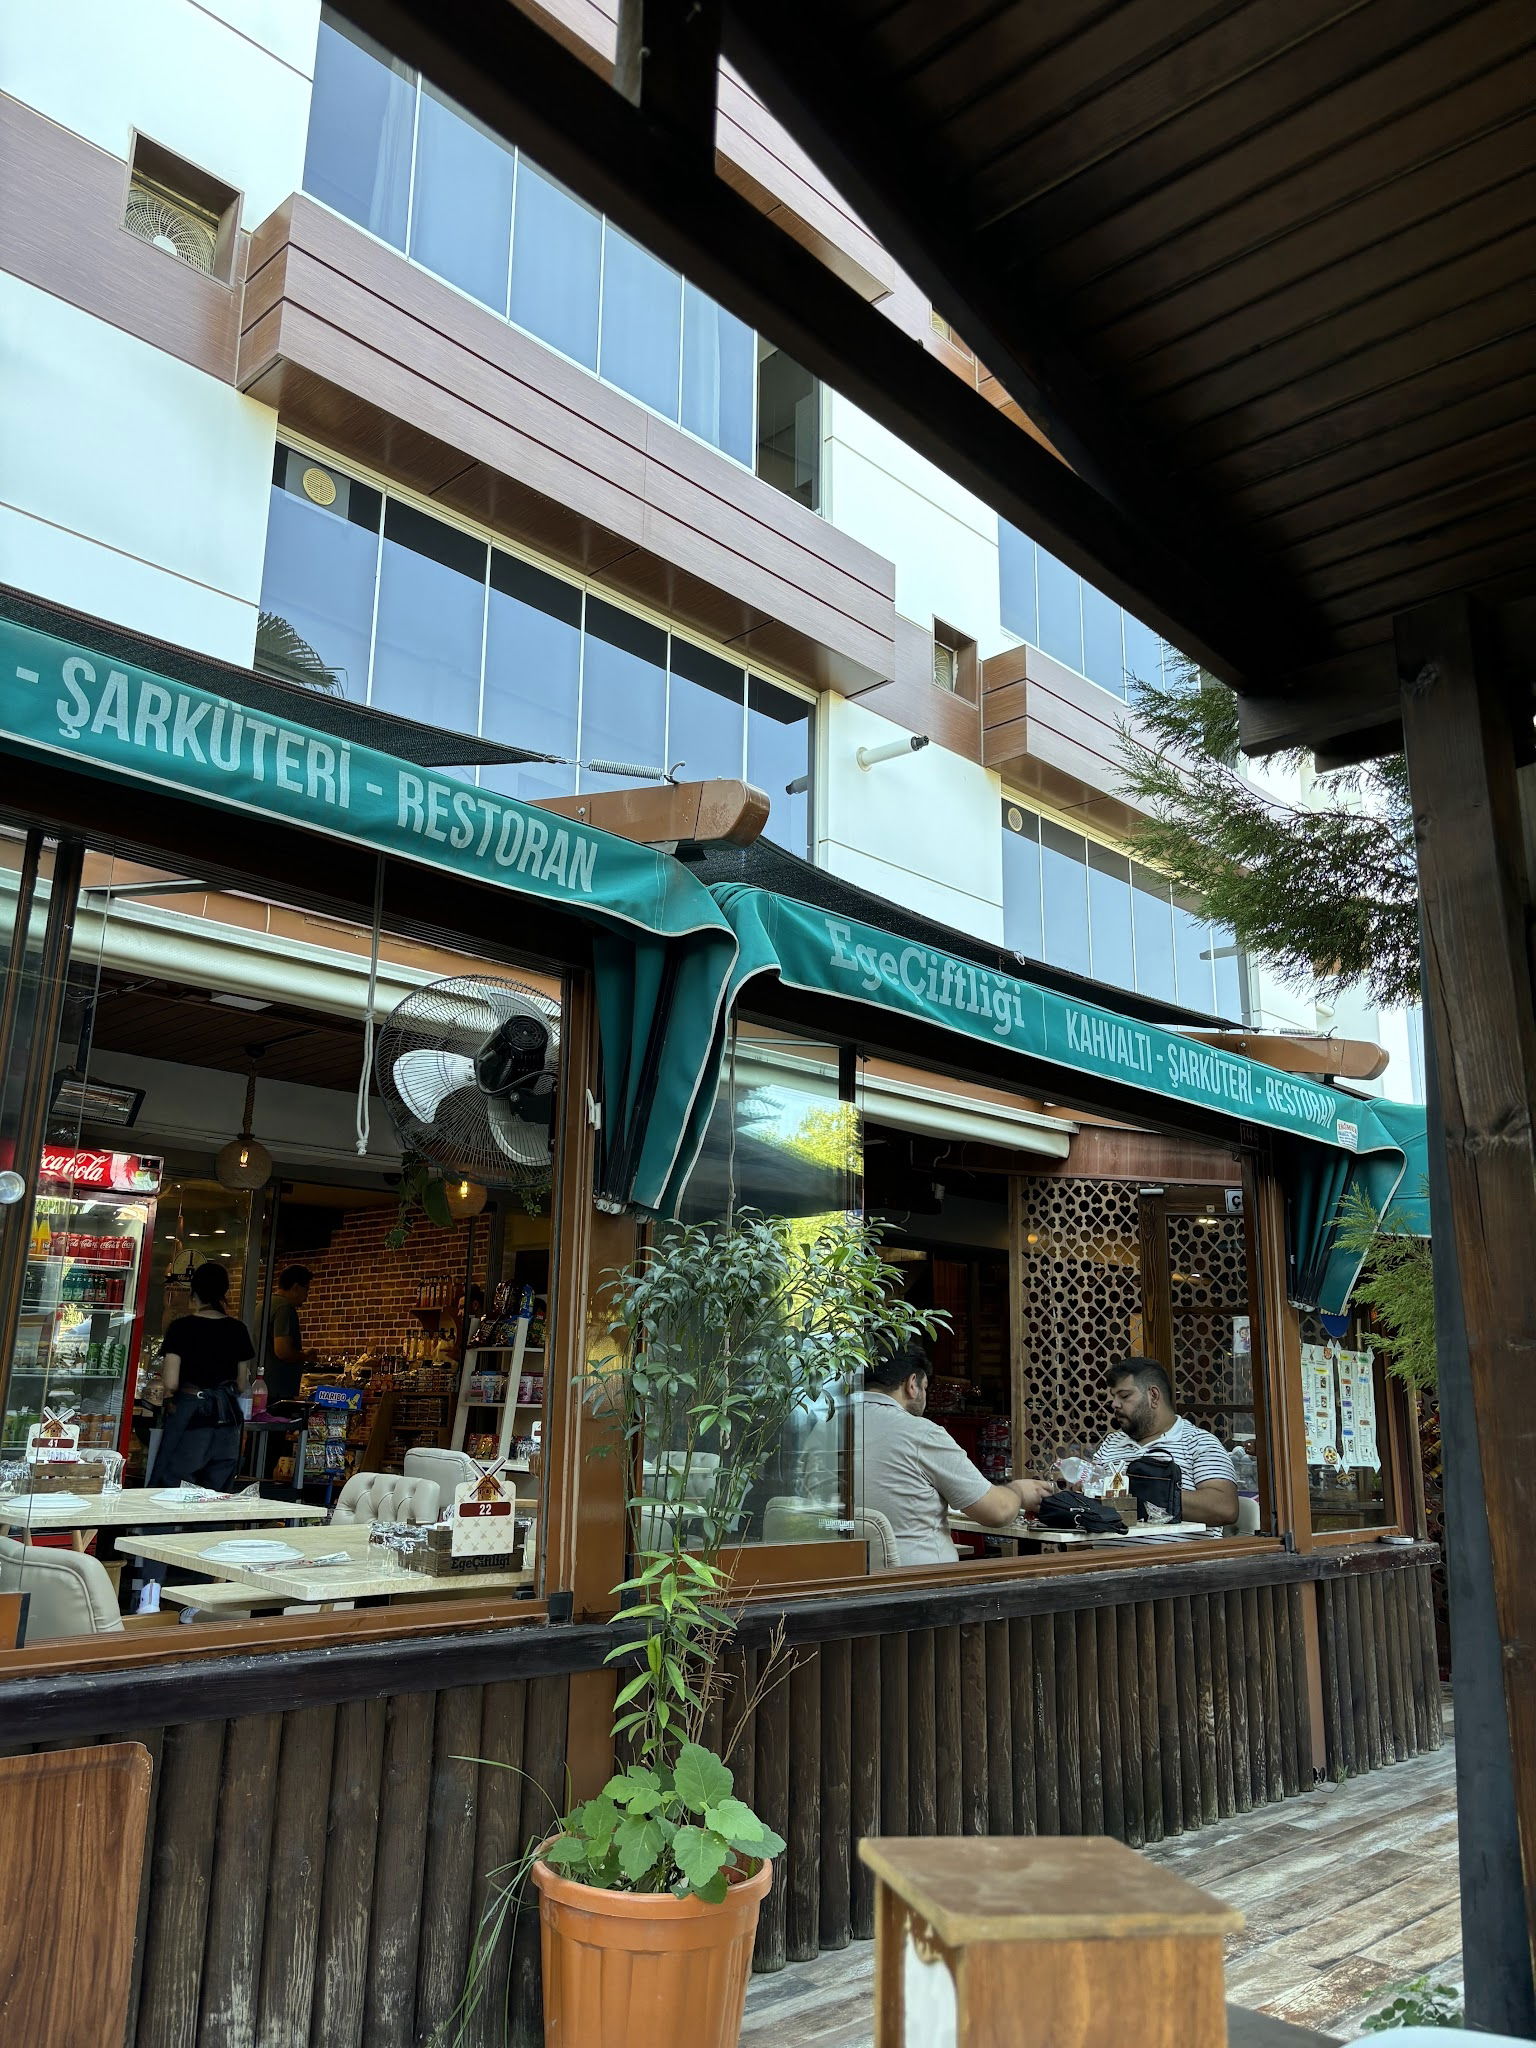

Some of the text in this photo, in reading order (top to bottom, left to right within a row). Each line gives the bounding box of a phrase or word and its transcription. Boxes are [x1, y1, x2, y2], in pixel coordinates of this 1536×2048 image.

[56, 656, 351, 809] ŞARKÜTERİ
[397, 770, 598, 893] RESTORAN
[824, 918, 1025, 1036] EgeÇiftliği
[1065, 1008, 1153, 1074] KAHVALTI
[1167, 1043, 1254, 1105] ŞARKÜTERİ
[1265, 1077, 1337, 1129] RESTORAN
[319, 1391, 347, 1401] HARIBO
[48, 1439, 59, 1448] 41
[479, 1503, 492, 1516] 22
